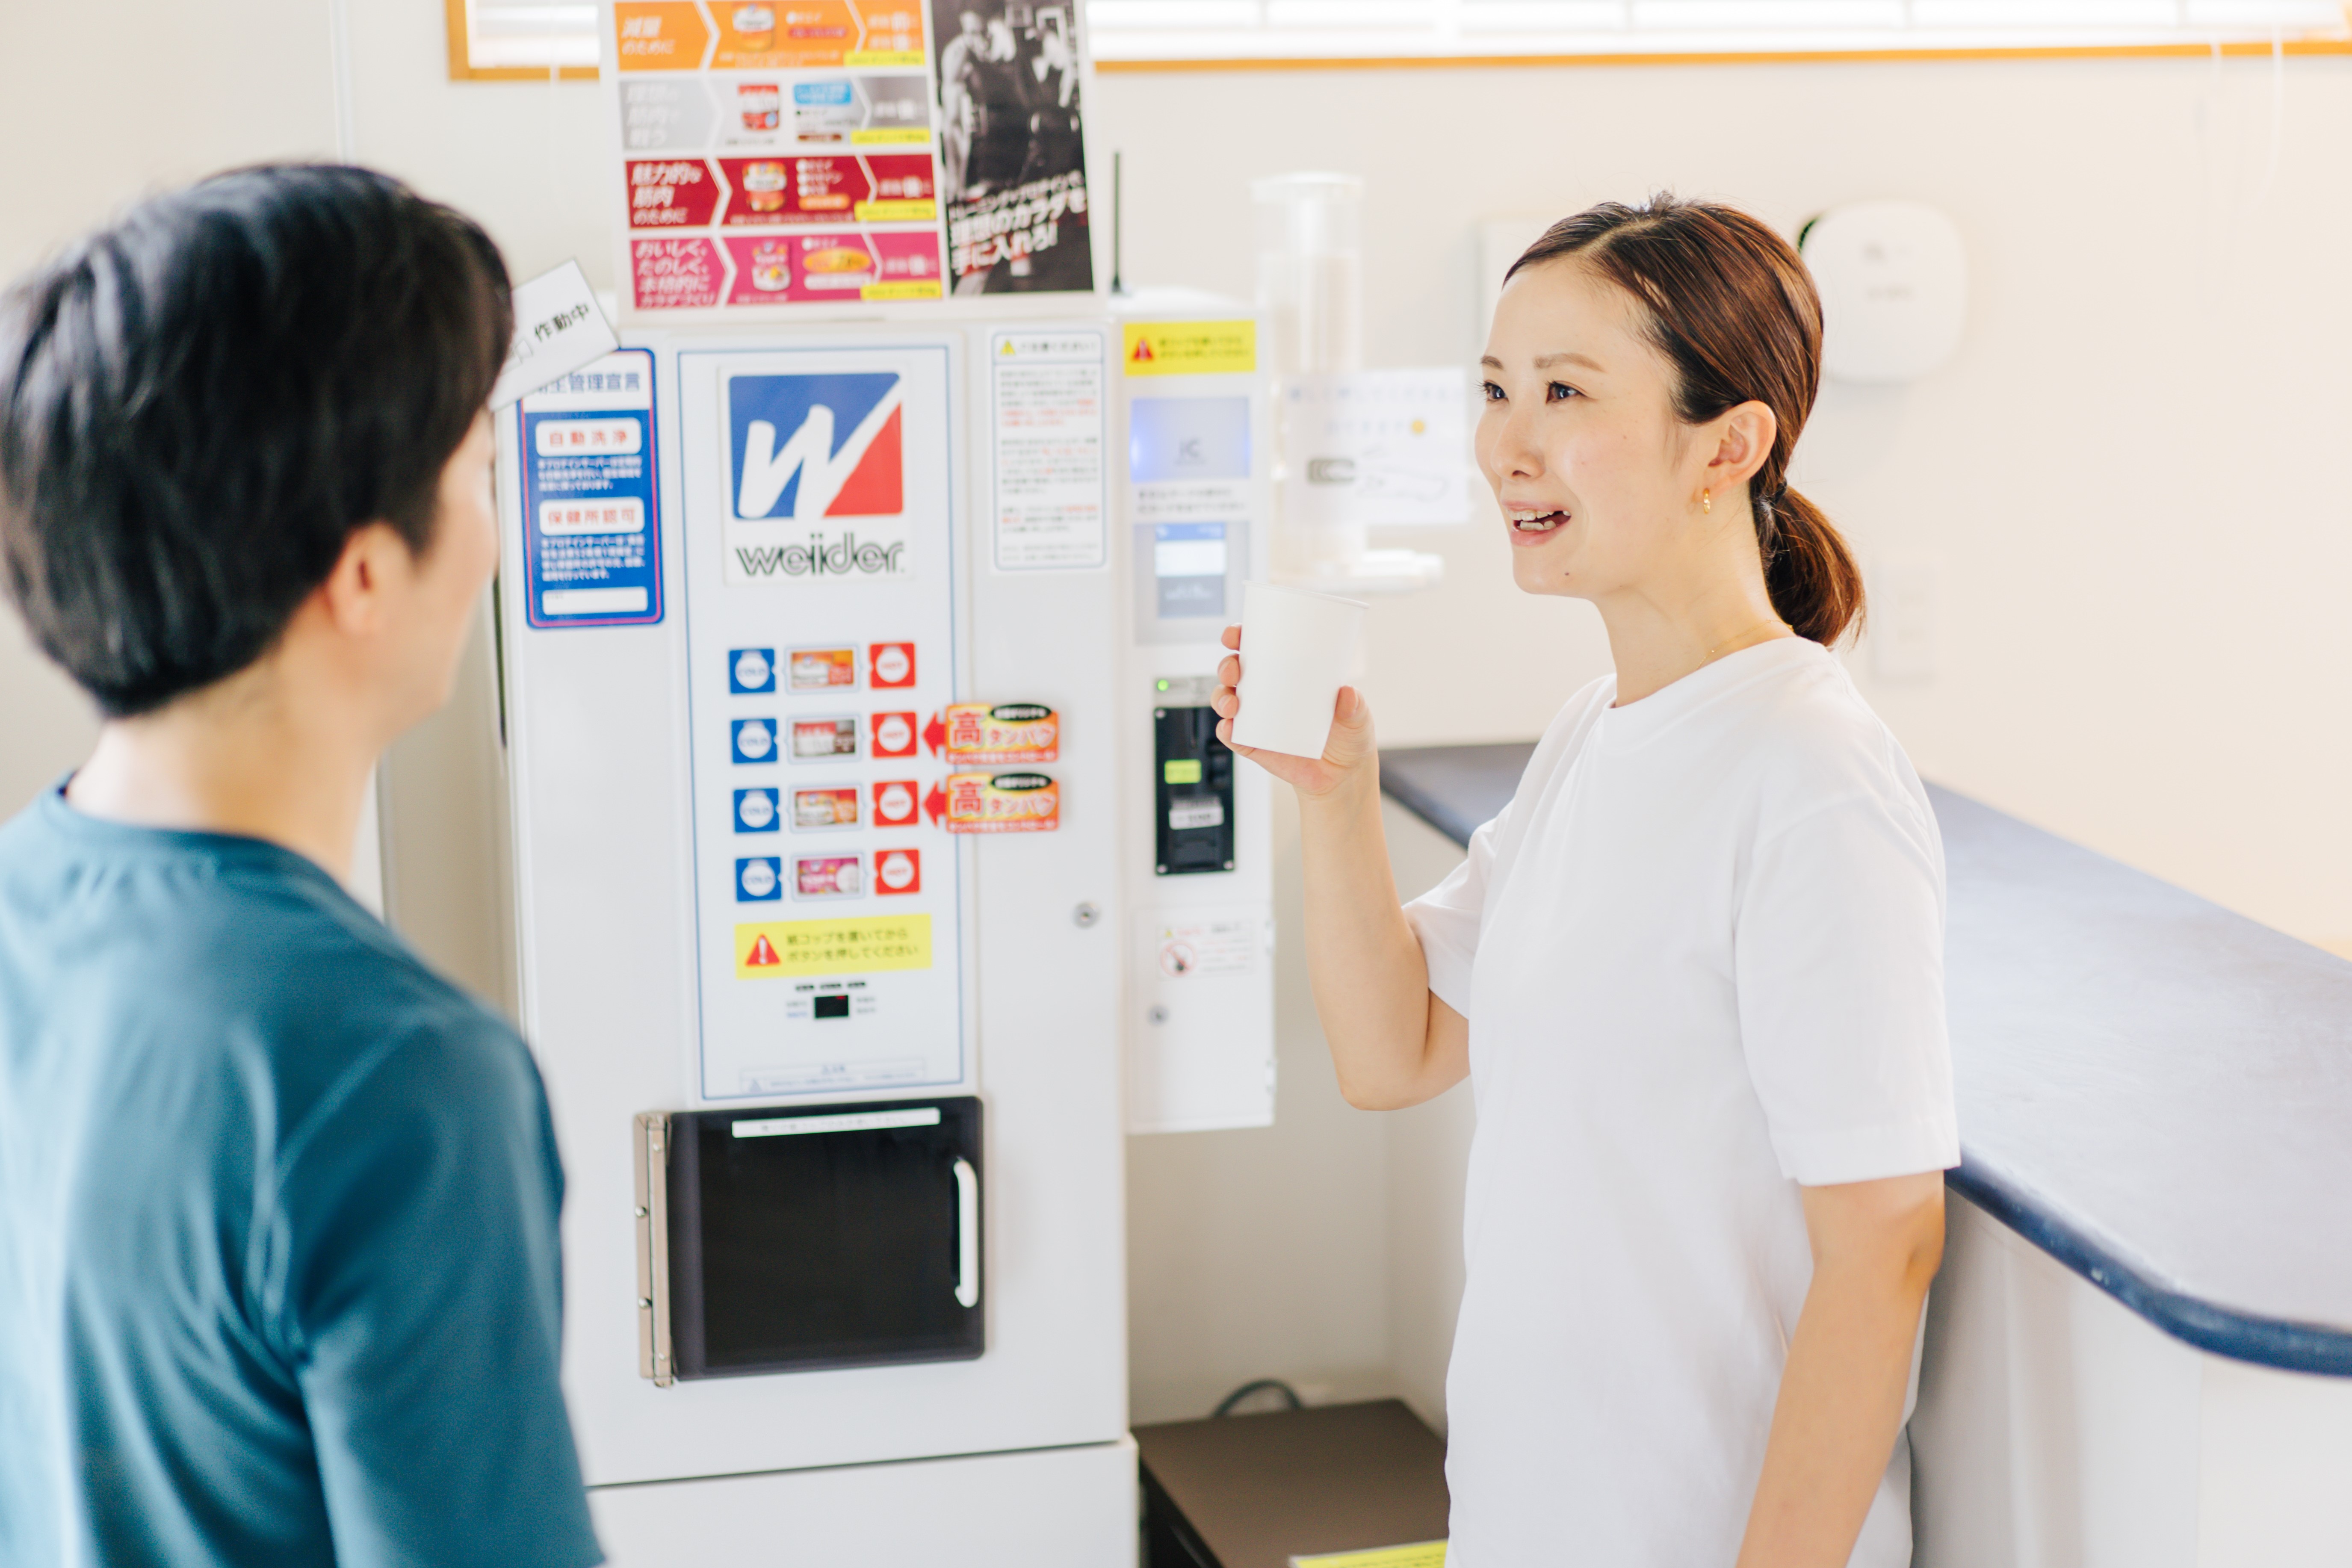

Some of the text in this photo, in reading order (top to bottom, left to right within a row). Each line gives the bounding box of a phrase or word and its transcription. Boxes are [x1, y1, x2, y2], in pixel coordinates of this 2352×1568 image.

[633, 185, 674, 208] 筋肉
[633, 208, 687, 224] のために
[534, 302, 589, 342] 作動中
[550, 430, 627, 447] 自動洗浄
[548, 507, 635, 526] 保健所認可
[787, 927, 908, 945] 紙コップを置いてから
[787, 945, 919, 963] ボタンを押してください
